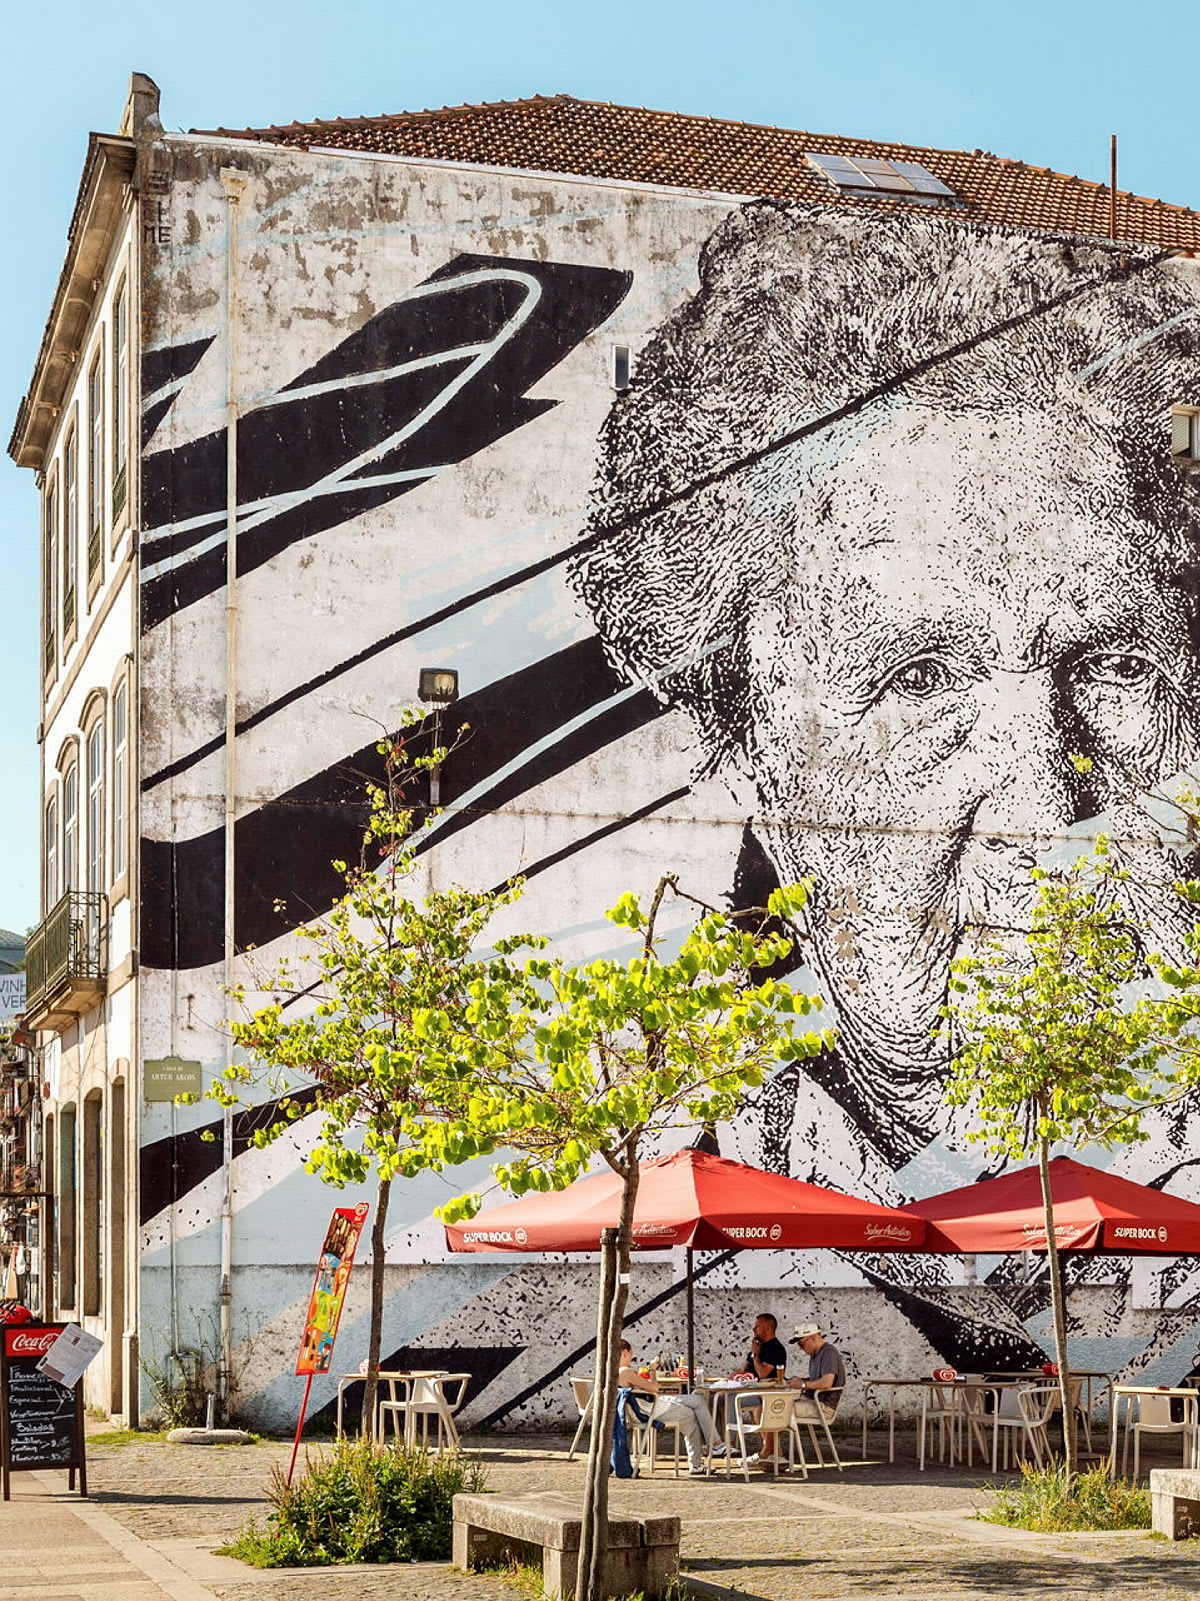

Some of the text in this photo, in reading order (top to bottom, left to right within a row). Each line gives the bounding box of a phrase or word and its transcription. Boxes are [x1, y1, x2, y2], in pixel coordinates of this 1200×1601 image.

[463, 1232, 489, 1243] SUPER
[489, 1231, 513, 1242] BOCK
[745, 1227, 768, 1238] BOCK
[1114, 1227, 1138, 1238] SUPER
[1137, 1228, 1157, 1239] BOCK
